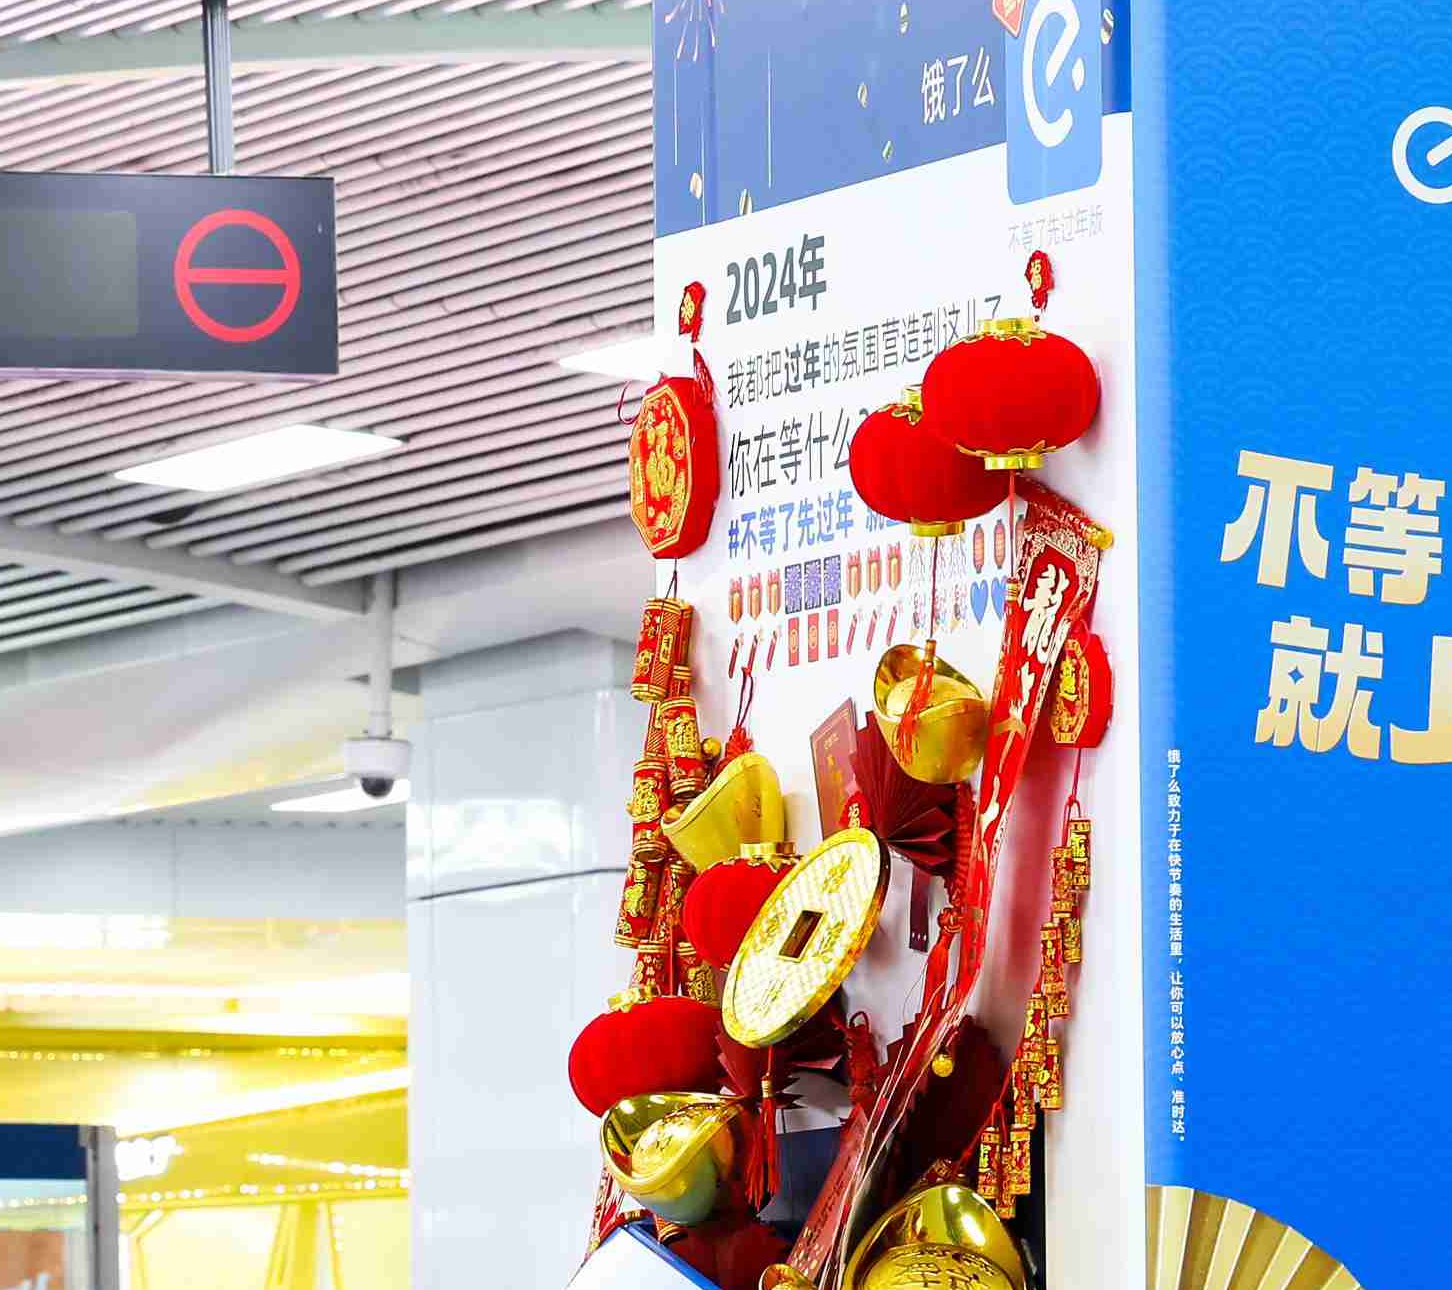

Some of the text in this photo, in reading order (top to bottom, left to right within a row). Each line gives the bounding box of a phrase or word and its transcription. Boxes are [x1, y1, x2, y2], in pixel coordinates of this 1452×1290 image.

[920, 47, 995, 128] 饿了么
[726, 233, 827, 326] 2024年
[728, 408, 869, 500] 你在等什么
[728, 488, 854, 560] #不等了先过年
